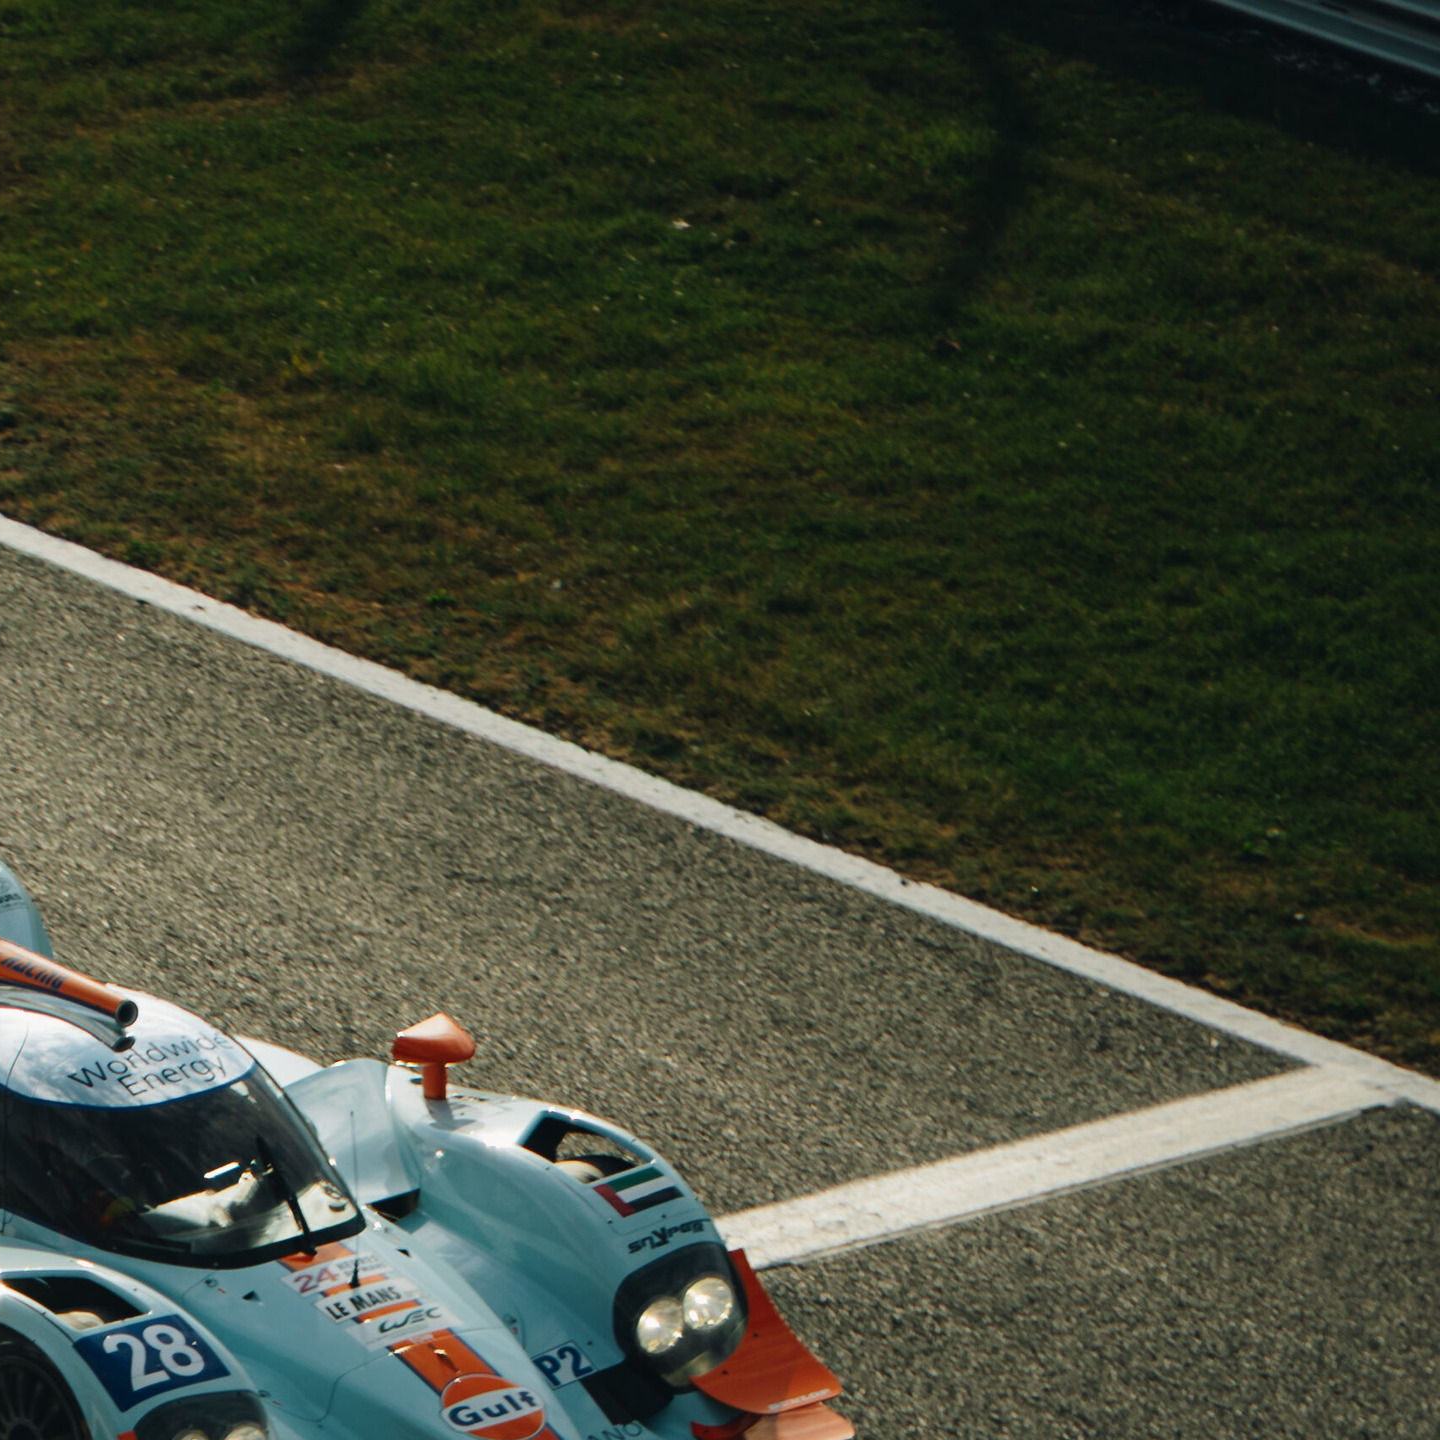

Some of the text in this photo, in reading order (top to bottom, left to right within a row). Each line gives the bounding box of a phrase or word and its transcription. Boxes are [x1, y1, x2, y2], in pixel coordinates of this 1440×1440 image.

[67, 1032, 235, 1088] Worldwide
[117, 1056, 227, 1097] Energy
[293, 1267, 339, 1294] 24
[325, 1301, 350, 1320] LE
[379, 1306, 444, 1334] WEC
[103, 1324, 205, 1391] 28
[532, 1346, 594, 1387] P2
[448, 1390, 538, 1427] Gulf
